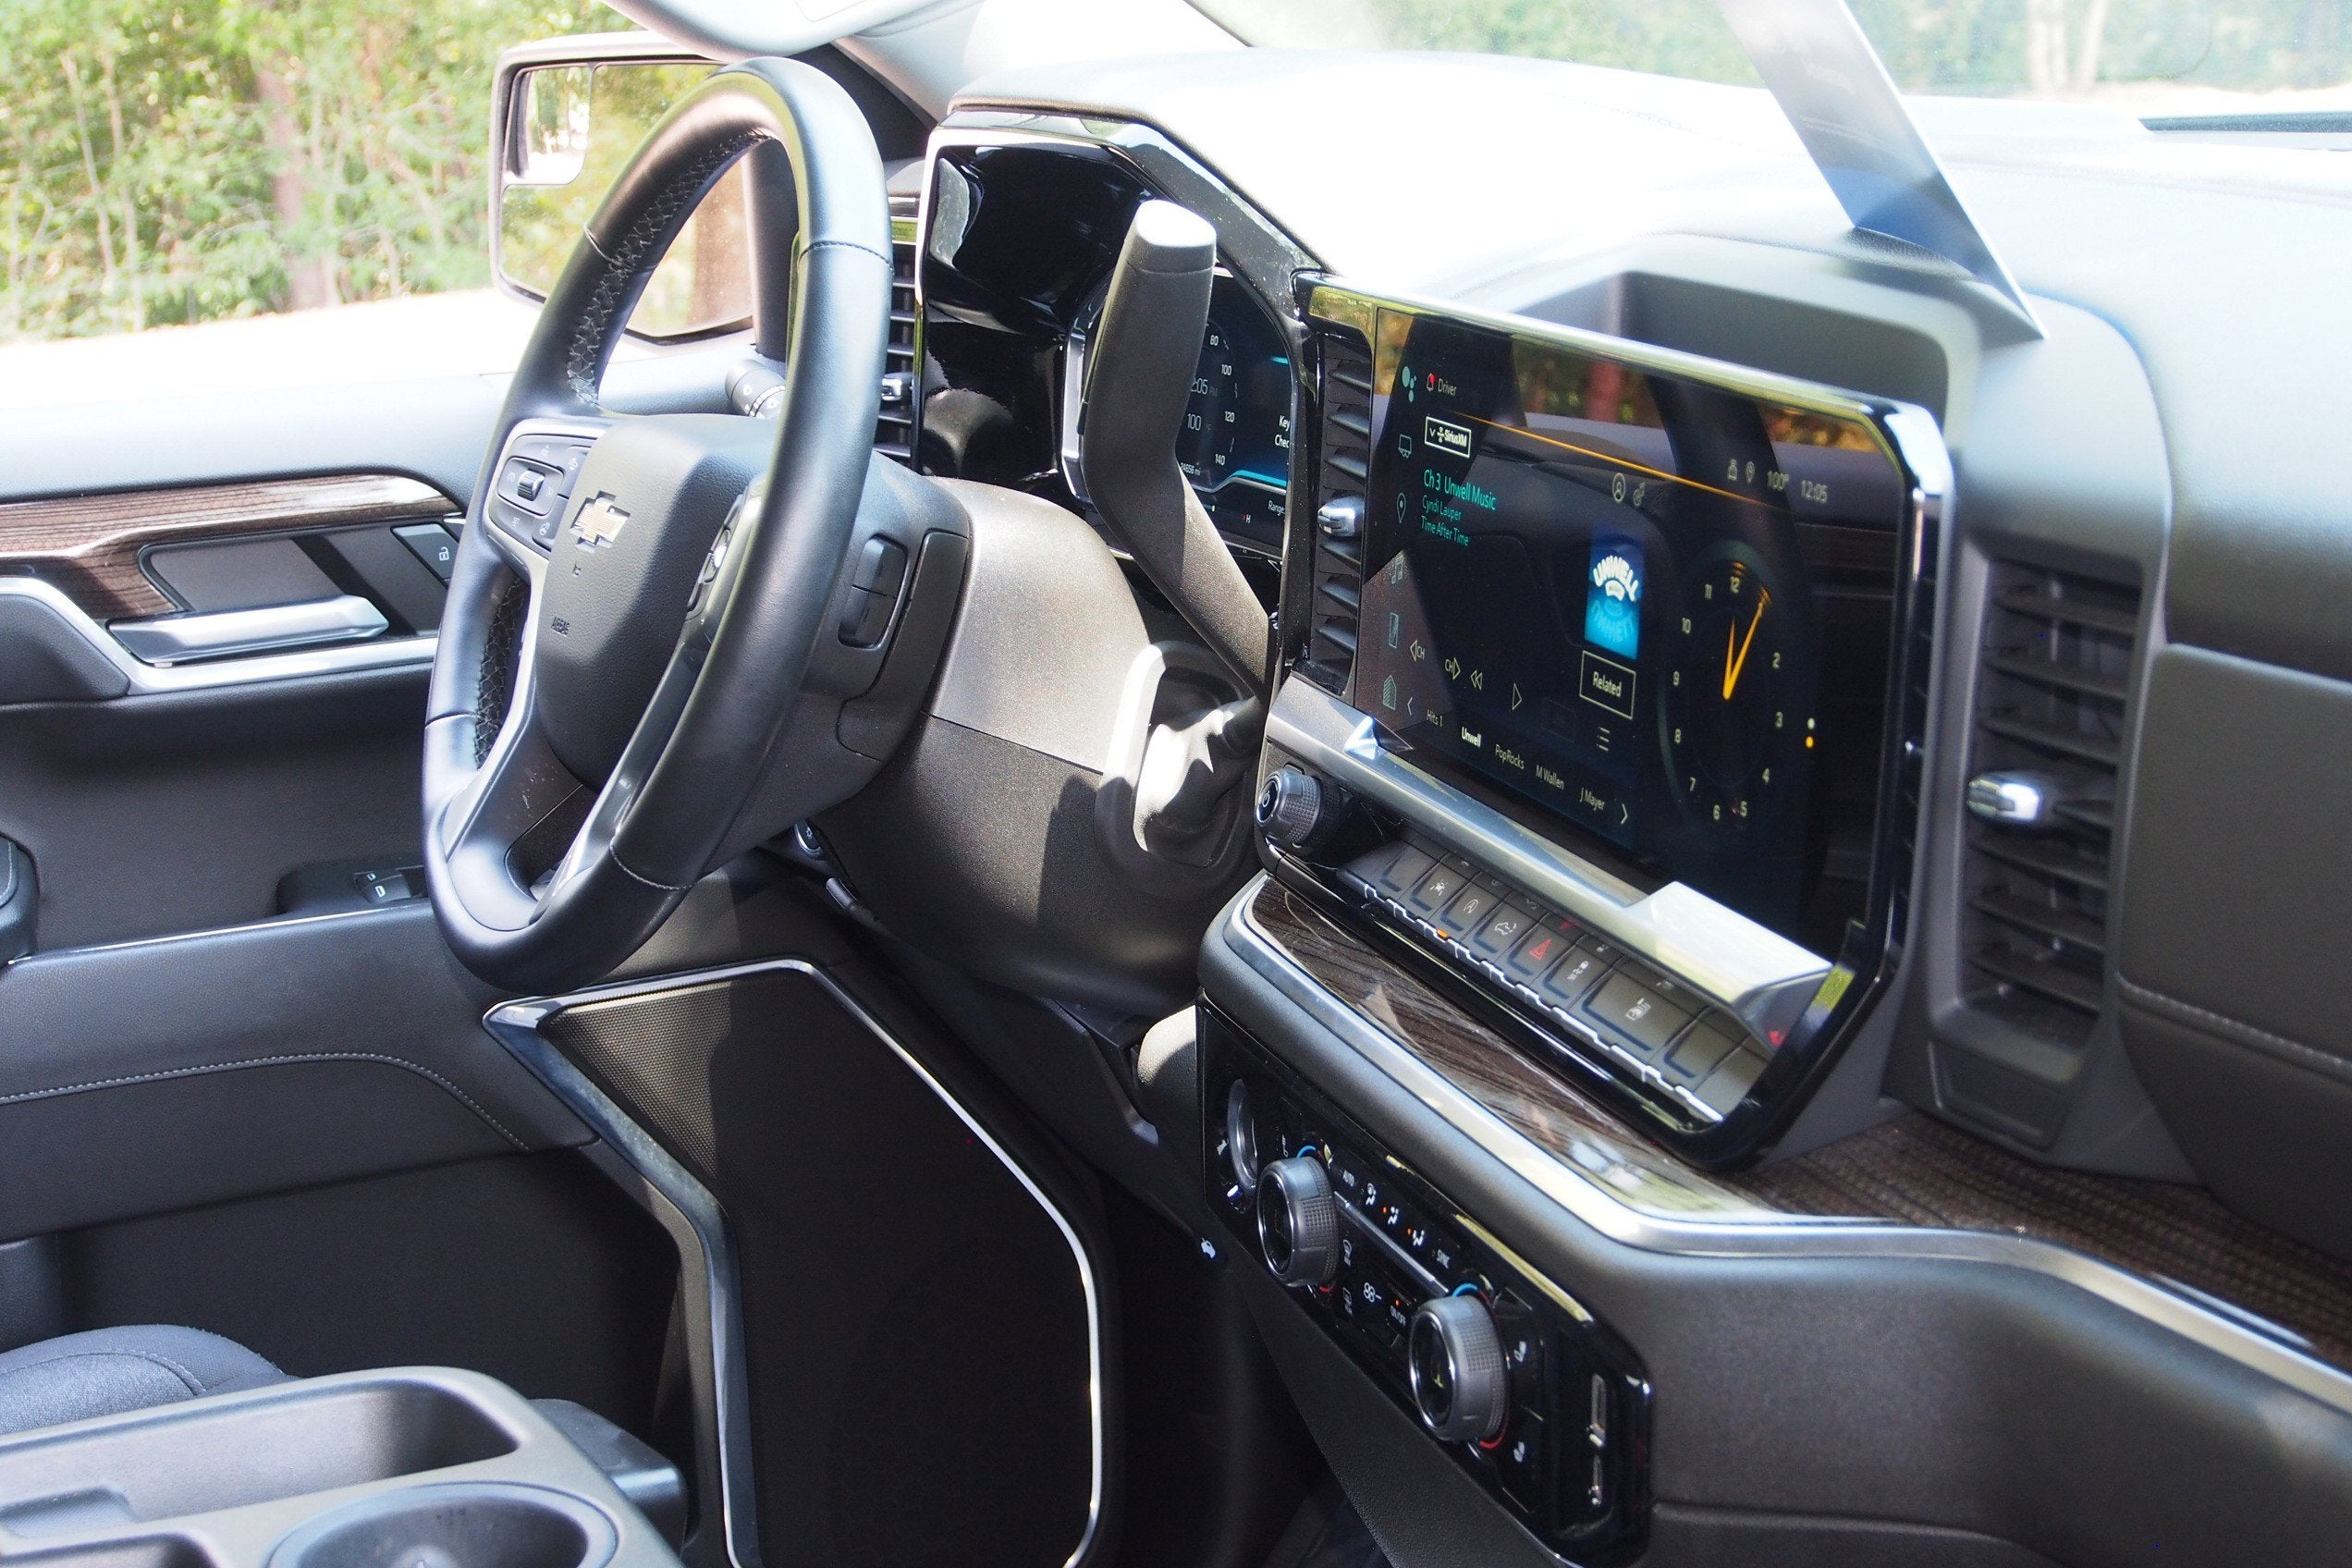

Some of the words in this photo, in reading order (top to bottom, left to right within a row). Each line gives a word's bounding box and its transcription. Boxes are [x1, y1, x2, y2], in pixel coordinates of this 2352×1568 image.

[1210, 335, 1219, 347] 80
[1220, 364, 1232, 376] 100
[1438, 378, 1457, 397] Driver
[1187, 413, 1202, 431] 100
[1224, 410, 1235, 423] 120
[1279, 414, 1291, 432] Key
[1215, 453, 1226, 466] 140
[1424, 469, 1435, 489] Ch
[1435, 472, 1441, 491] 3
[1444, 475, 1471, 501] Unwell
[1471, 484, 1496, 511] Music
[1800, 479, 1829, 504] 12:05
[1268, 499, 1286, 517] Range
[1422, 495, 1439, 514] Cyndi
[1439, 501, 1462, 522] Lauper
[1421, 515, 1436, 534] Time
[1436, 521, 1453, 540] After
[1453, 527, 1470, 546] Time
[1730, 576, 1740, 594] 12
[1681, 617, 1692, 634] 10
[1771, 652, 1782, 669] 2
[1592, 671, 1623, 698] Related
[1672, 670, 1681, 687] 9
[1427, 709, 1439, 726] Hits
[1774, 711, 1784, 729] 3
[1462, 726, 1482, 748] Unwell
[1674, 728, 1683, 743] 8
[1495, 743, 1525, 770] PopRocks
[1543, 767, 1564, 790] Wallen
[1689, 777, 1697, 791] 7
[1761, 767, 1770, 784] 4
[1584, 790, 1605, 811] Mayer
[1712, 804, 1721, 821] 6
